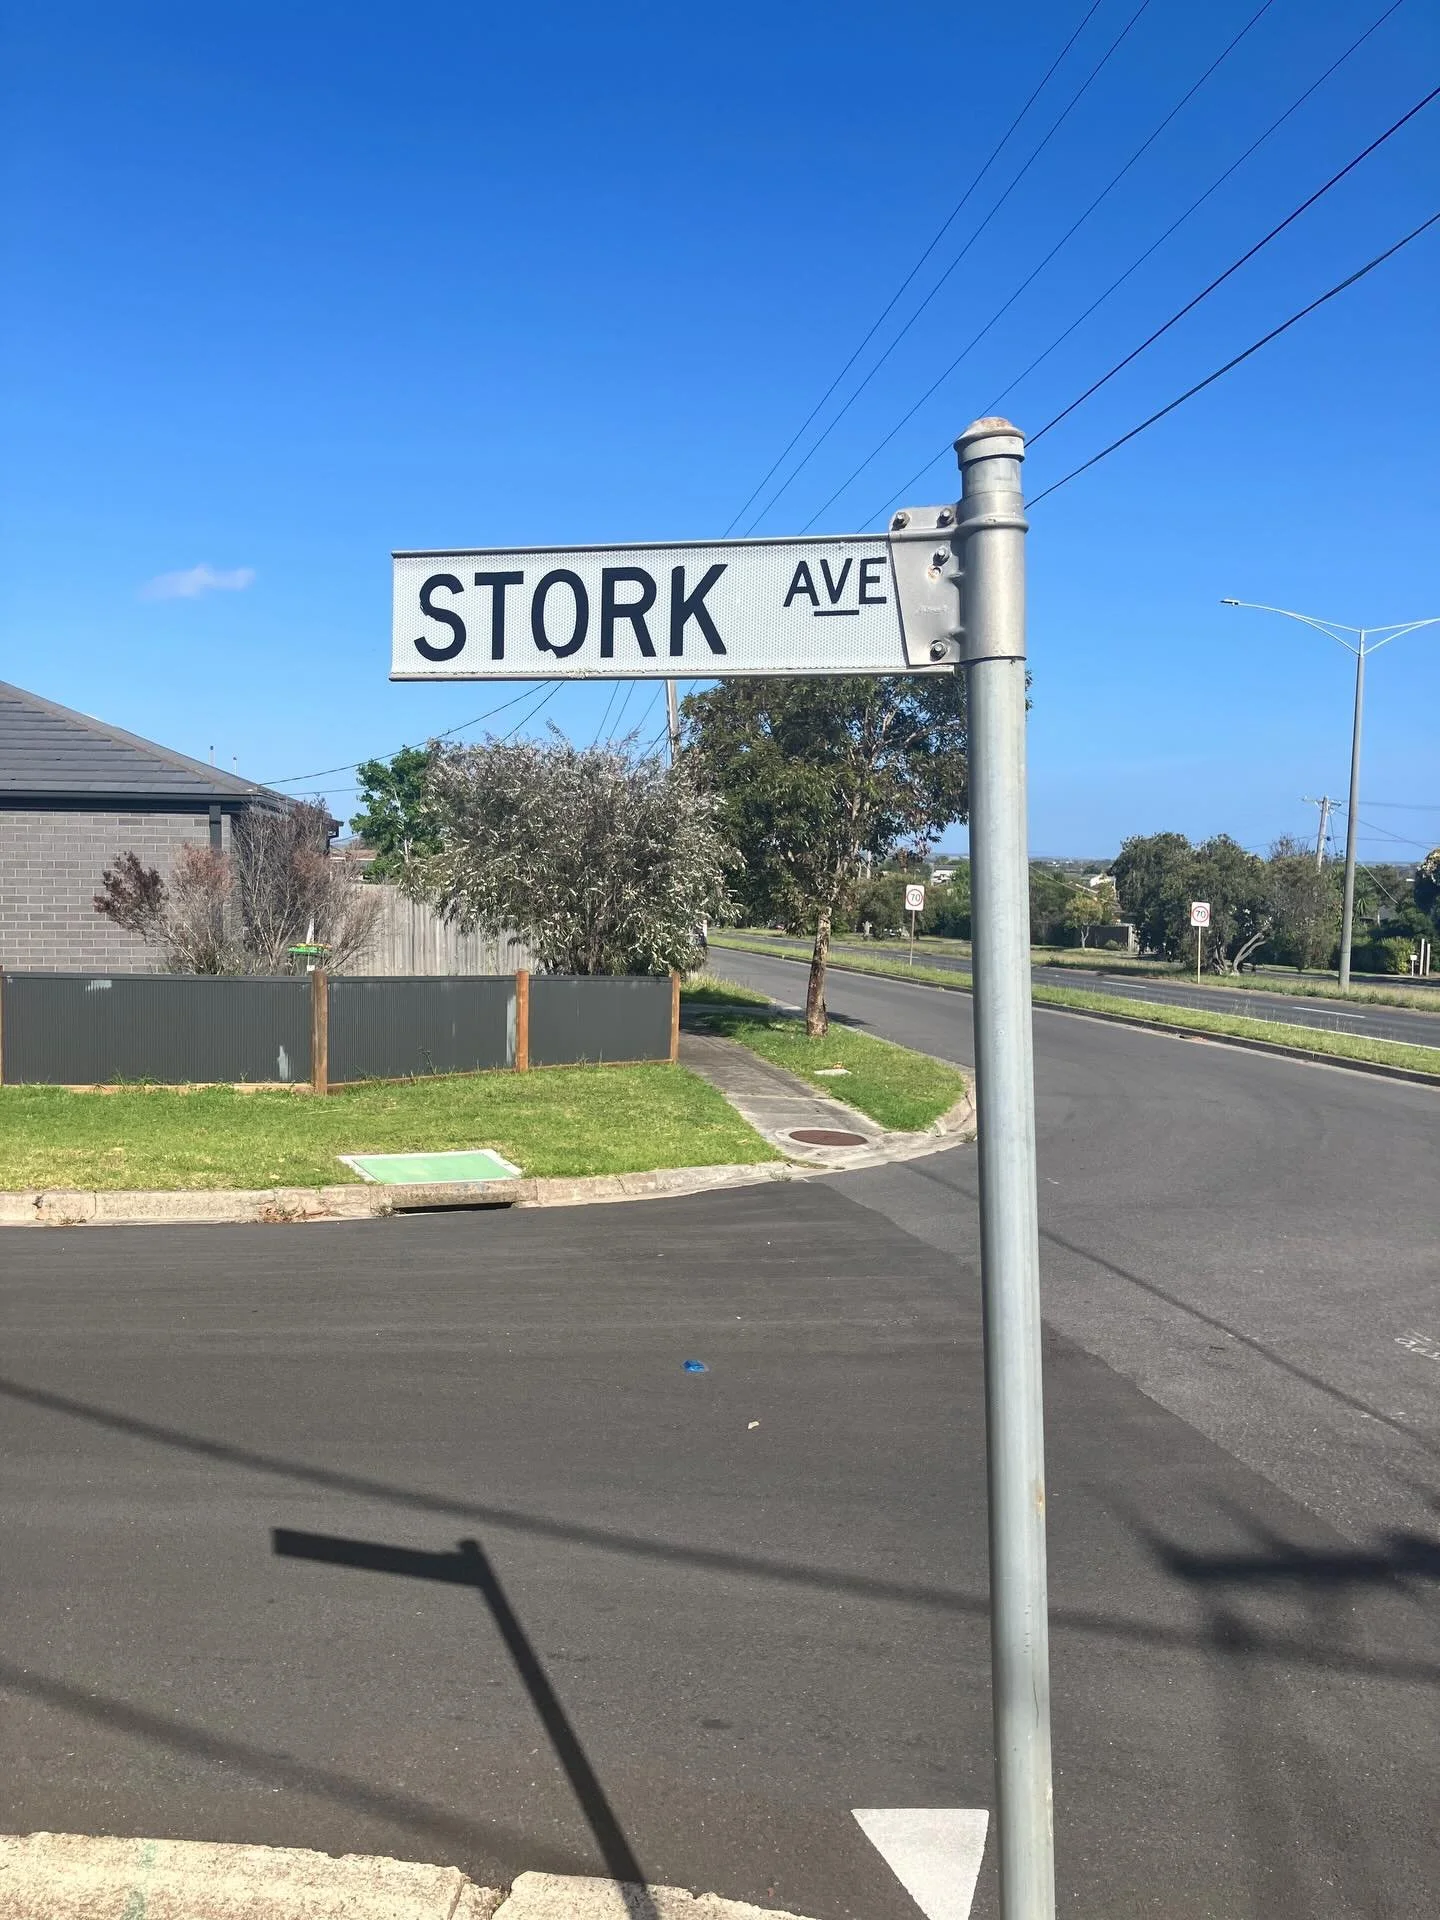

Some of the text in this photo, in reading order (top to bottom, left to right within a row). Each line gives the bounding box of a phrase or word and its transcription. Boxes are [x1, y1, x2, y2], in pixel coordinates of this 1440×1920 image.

[413, 556, 887, 662] STORK AVE
[910, 893, 921, 902] 70
[1195, 910, 1206, 919] 70
